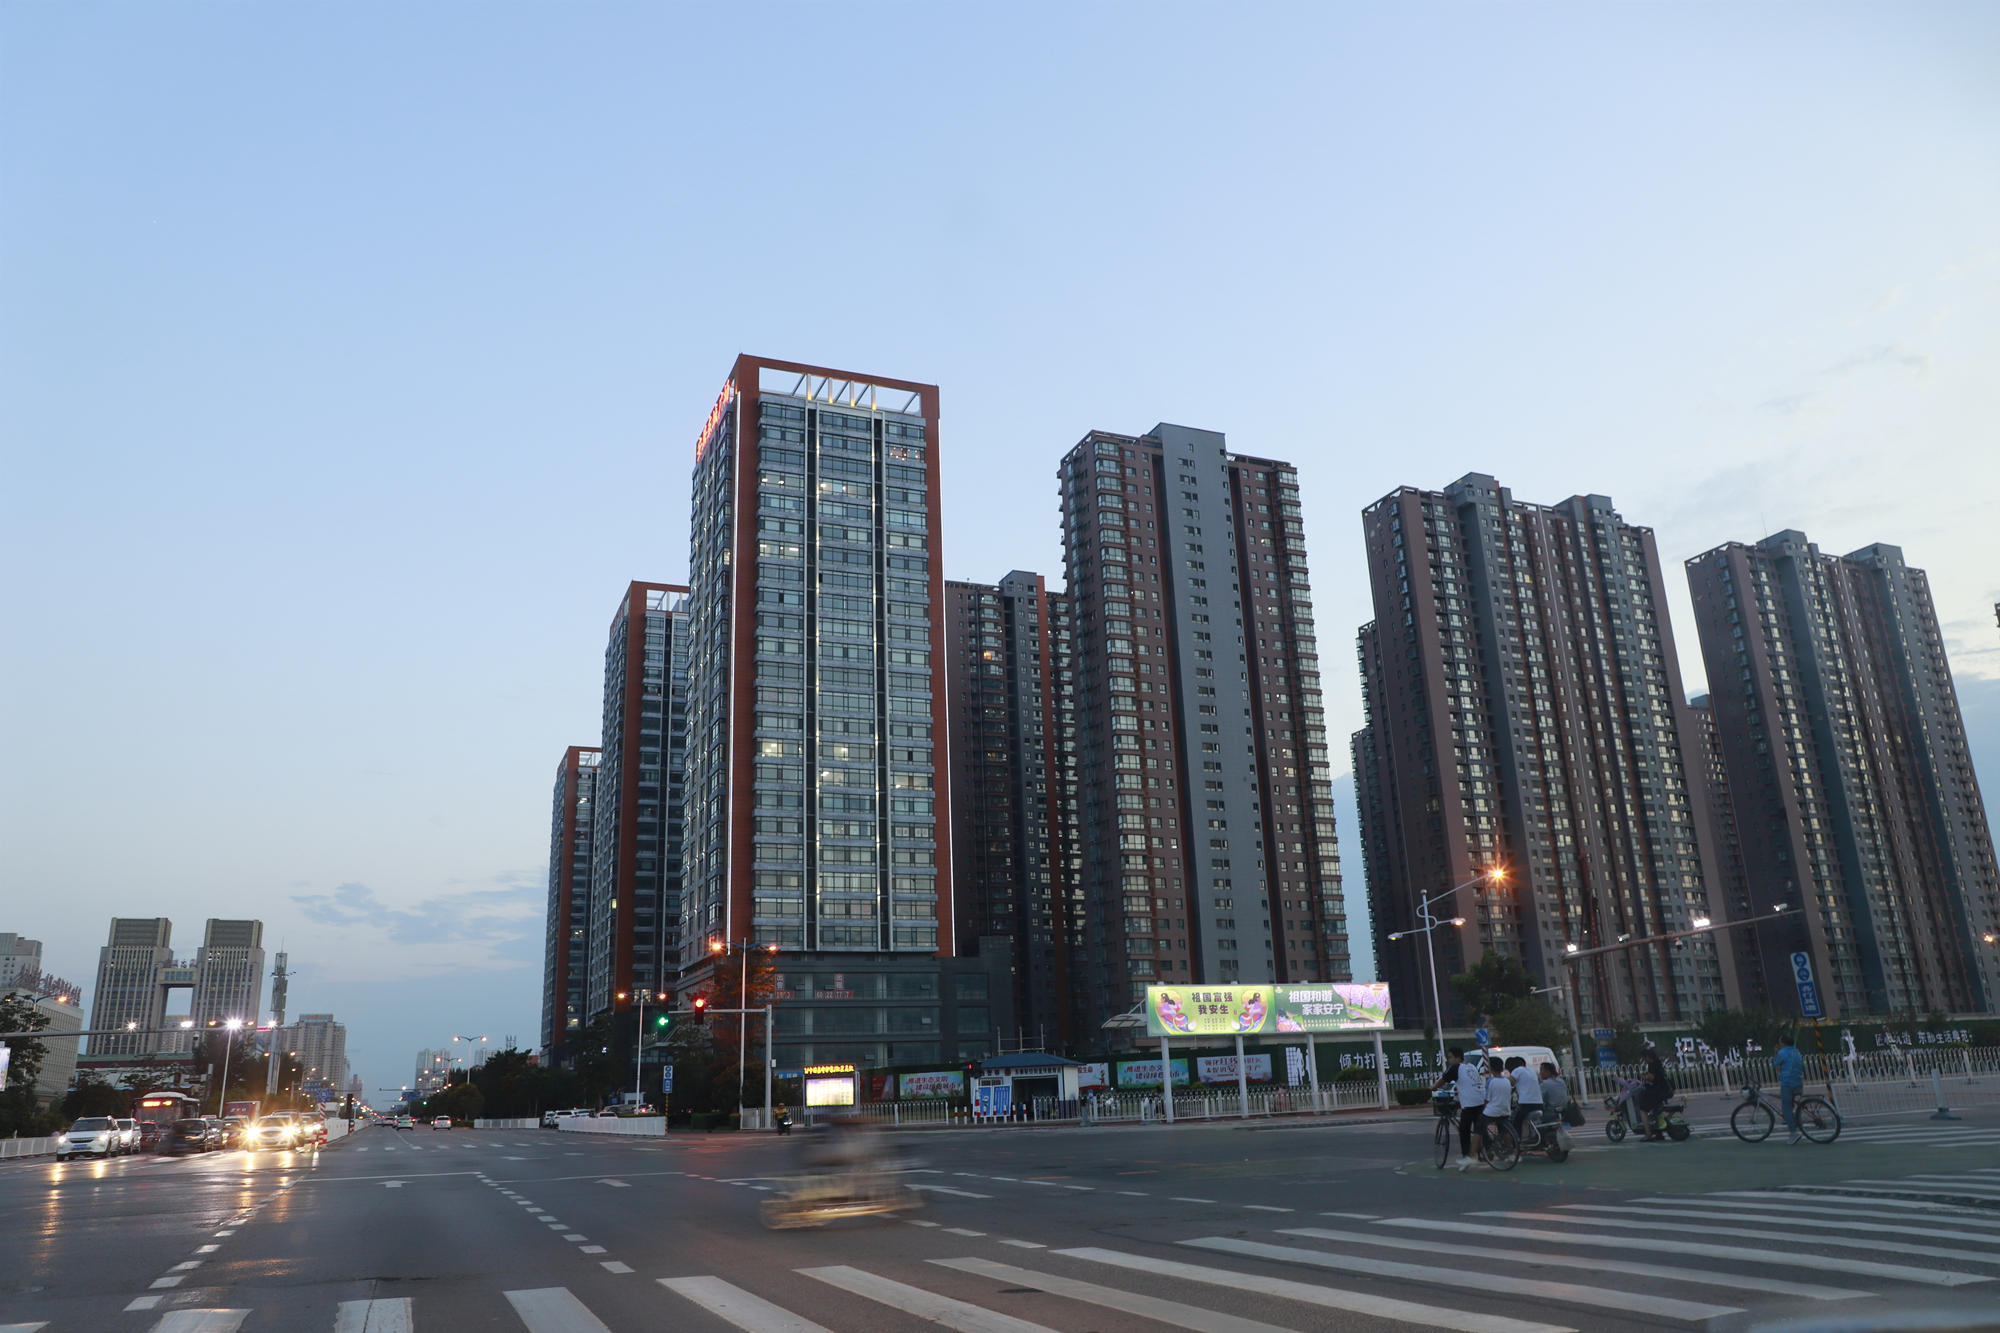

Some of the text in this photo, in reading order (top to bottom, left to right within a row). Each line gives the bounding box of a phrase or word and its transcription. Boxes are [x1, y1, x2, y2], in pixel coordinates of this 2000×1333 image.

[1192, 992, 1233, 1003] 祖国富强
[1289, 990, 1333, 1003] 祖国和谐
[1302, 1003, 1344, 1016] 家家安宁
